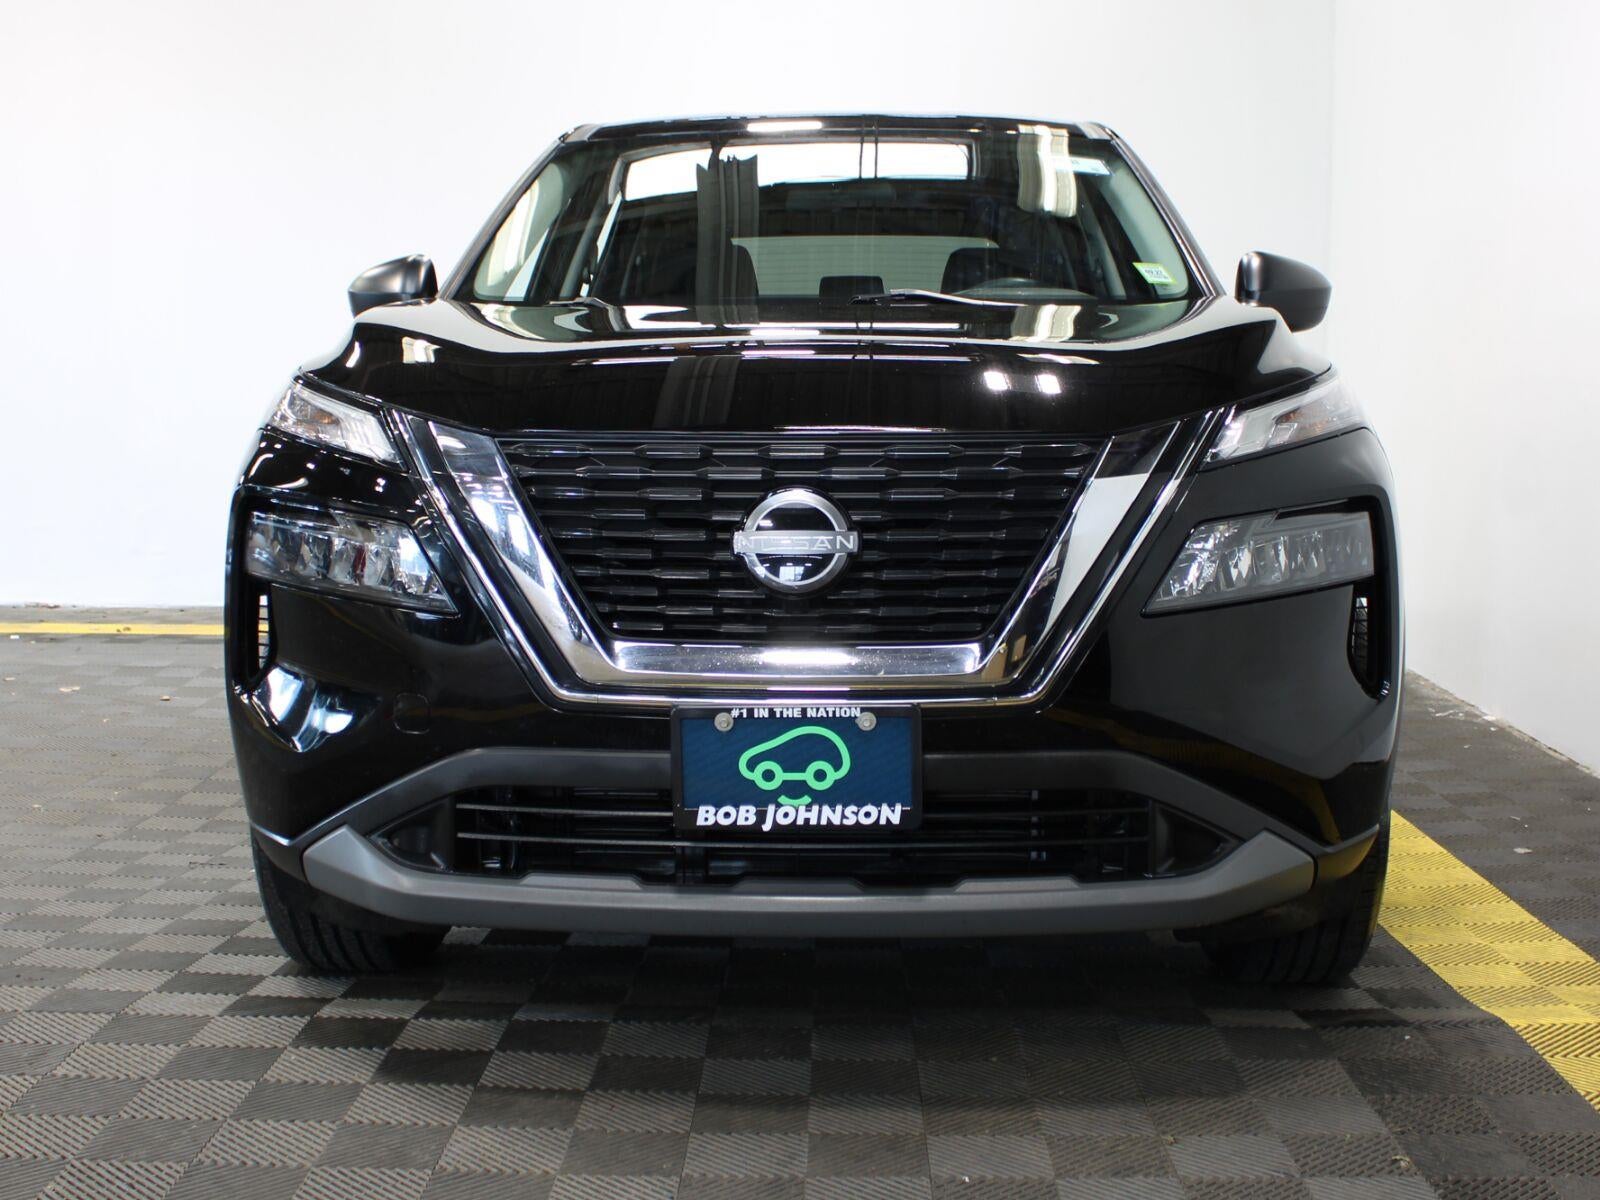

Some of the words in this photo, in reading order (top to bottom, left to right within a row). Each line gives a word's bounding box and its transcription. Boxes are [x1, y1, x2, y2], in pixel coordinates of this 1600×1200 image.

[738, 535, 854, 550] NISSAN
[730, 708, 748, 718] #1
[753, 708, 769, 718] IN
[773, 707, 803, 718] THE
[806, 706, 861, 718] NATION
[696, 804, 757, 826] BOB
[761, 803, 902, 832] JOHNSON
